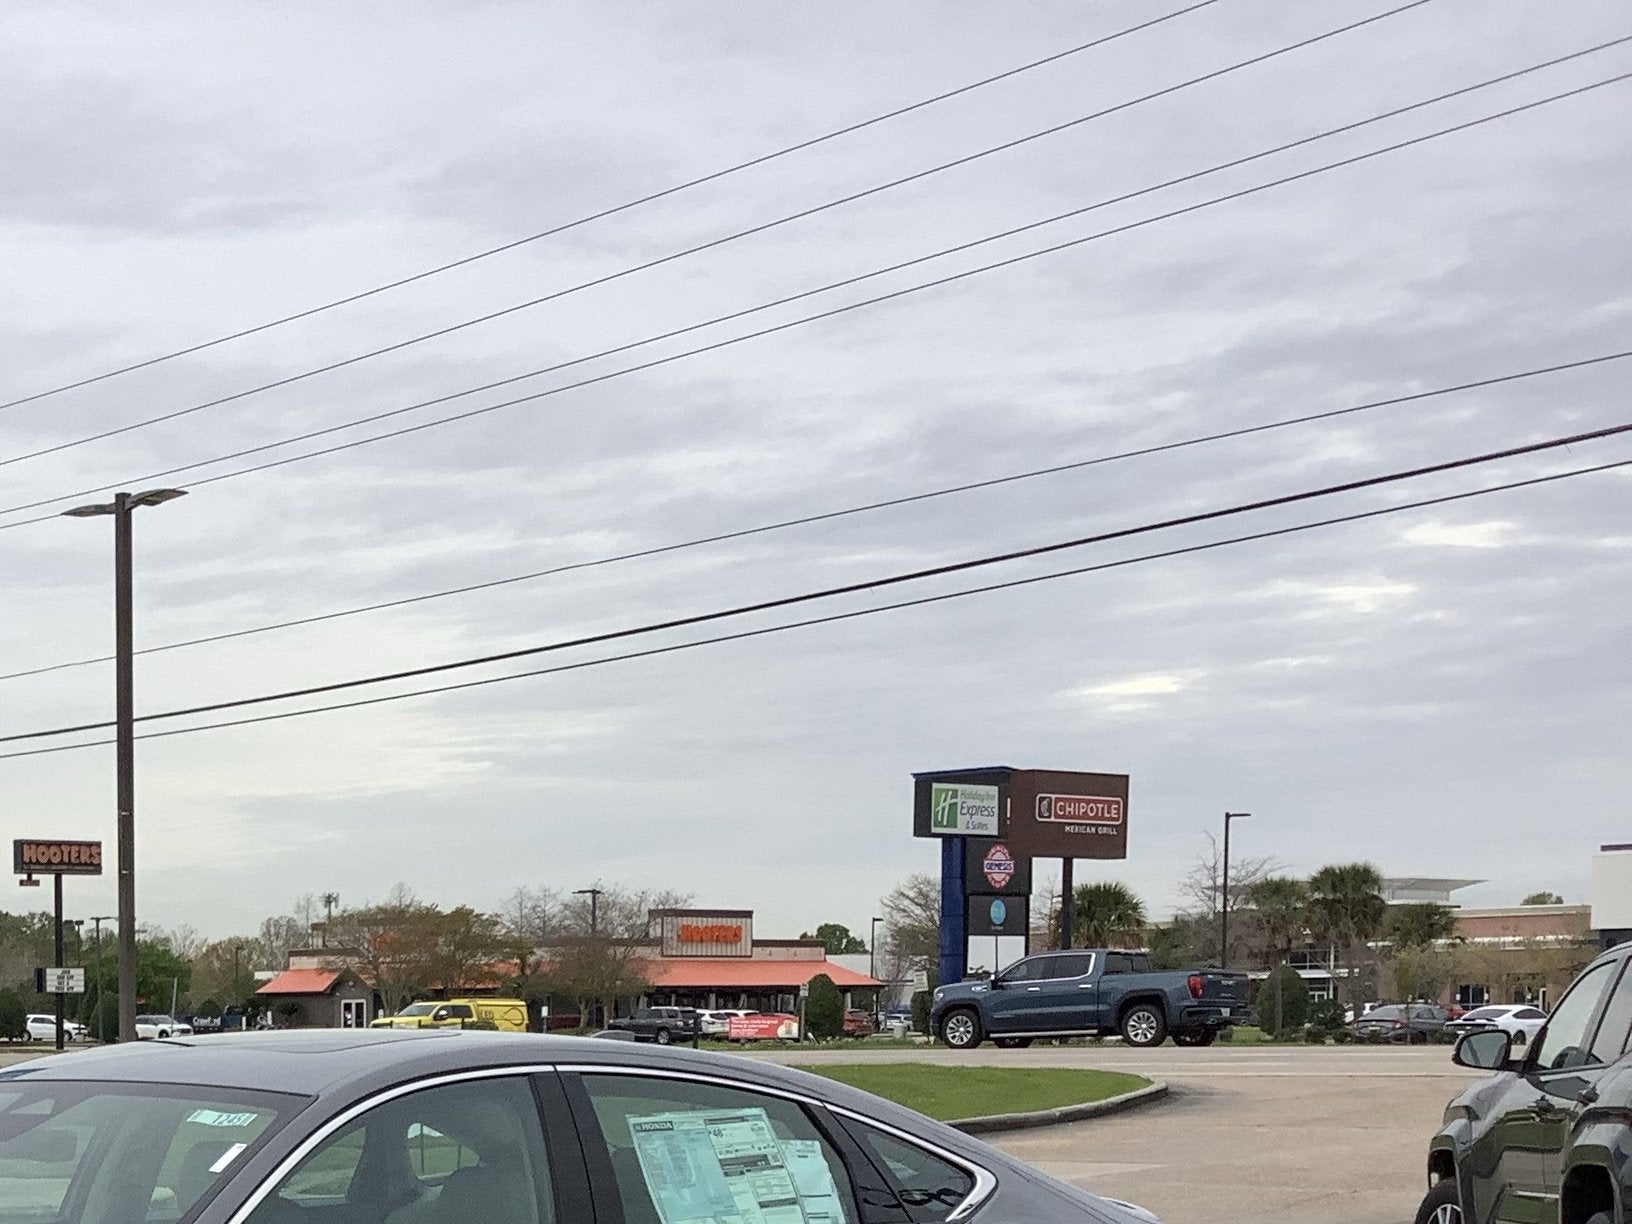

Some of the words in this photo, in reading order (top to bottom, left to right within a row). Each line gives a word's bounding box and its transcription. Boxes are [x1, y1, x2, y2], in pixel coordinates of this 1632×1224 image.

[960, 801, 996, 820] Express
[1056, 801, 1119, 818] CHIPOTLE
[1064, 825, 1096, 835] MEXICAN
[1097, 827, 1118, 835] GRILL
[22, 843, 101, 865] HOOTERS
[985, 862, 1013, 871] GENESIS
[193, 1016, 222, 1027] Crawfrd
[641, 1121, 673, 1132] HONDA
